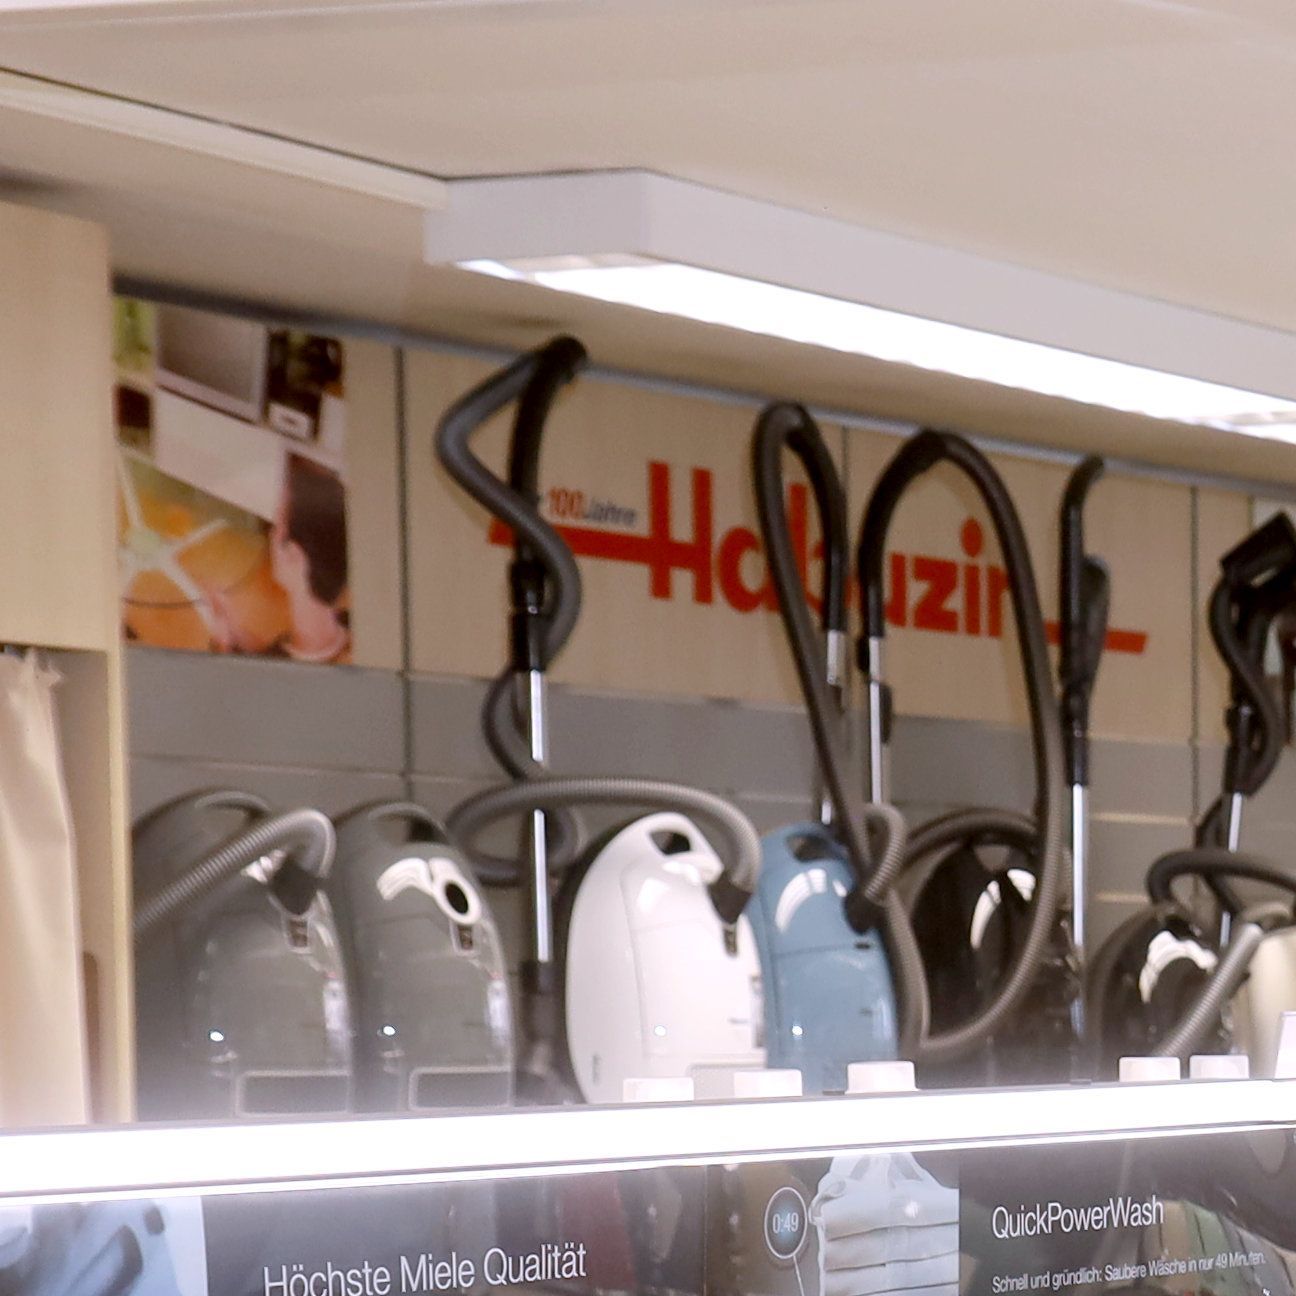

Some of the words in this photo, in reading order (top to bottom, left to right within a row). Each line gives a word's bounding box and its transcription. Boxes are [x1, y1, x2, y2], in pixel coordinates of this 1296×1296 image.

[549, 486, 584, 519] 100
[584, 497, 637, 527] Jahre
[772, 1211, 800, 1233] 0:49
[991, 1194, 1165, 1240] QuickPowerWash
[400, 1251, 476, 1294] Miele
[483, 1241, 588, 1287] Qualität
[991, 1273, 1029, 1294] Schnell
[1030, 1270, 1051, 1288] und
[1052, 1264, 1103, 1291] gründlich:
[1104, 1262, 1147, 1282] Saubere
[1148, 1257, 1187, 1277] Wäsche
[1187, 1257, 1198, 1272] in
[1198, 1257, 1214, 1272] nur
[1215, 1253, 1228, 1268] 49
